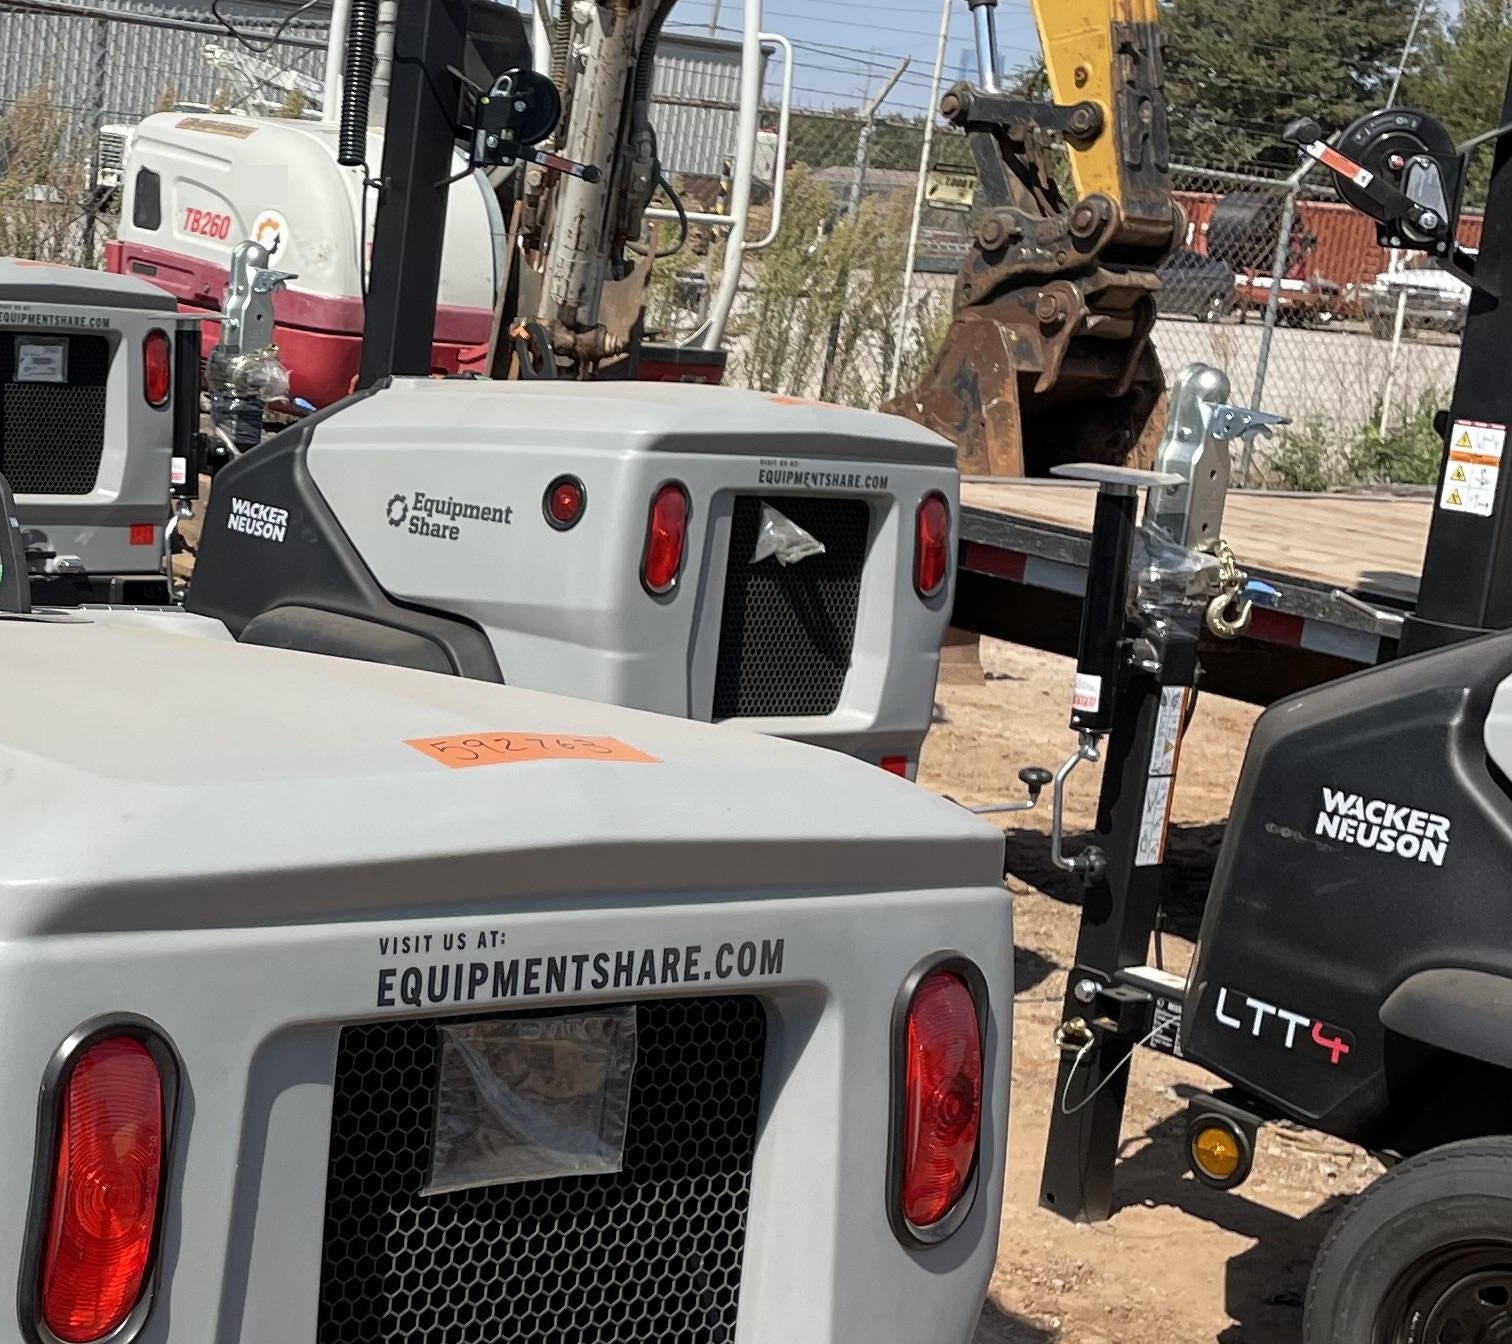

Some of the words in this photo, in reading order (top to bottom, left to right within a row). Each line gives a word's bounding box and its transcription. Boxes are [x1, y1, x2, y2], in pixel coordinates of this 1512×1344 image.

[183, 207, 231, 241] TB260
[758, 469, 888, 490] EQUIPMENTSHARE.COM
[231, 497, 289, 527] WACKER
[411, 491, 514, 525] Equipment
[226, 513, 287, 543] NEUSON
[408, 515, 461, 541] Share
[1322, 786, 1451, 843] WACKER
[1315, 810, 1449, 867] NEUSON
[379, 934, 433, 955] VISIT
[442, 932, 467, 951] US
[477, 929, 506, 949] AT:
[376, 938, 785, 1008] EQUIPMENTSHARE.COM
[1215, 986, 1350, 1065] LTT4
